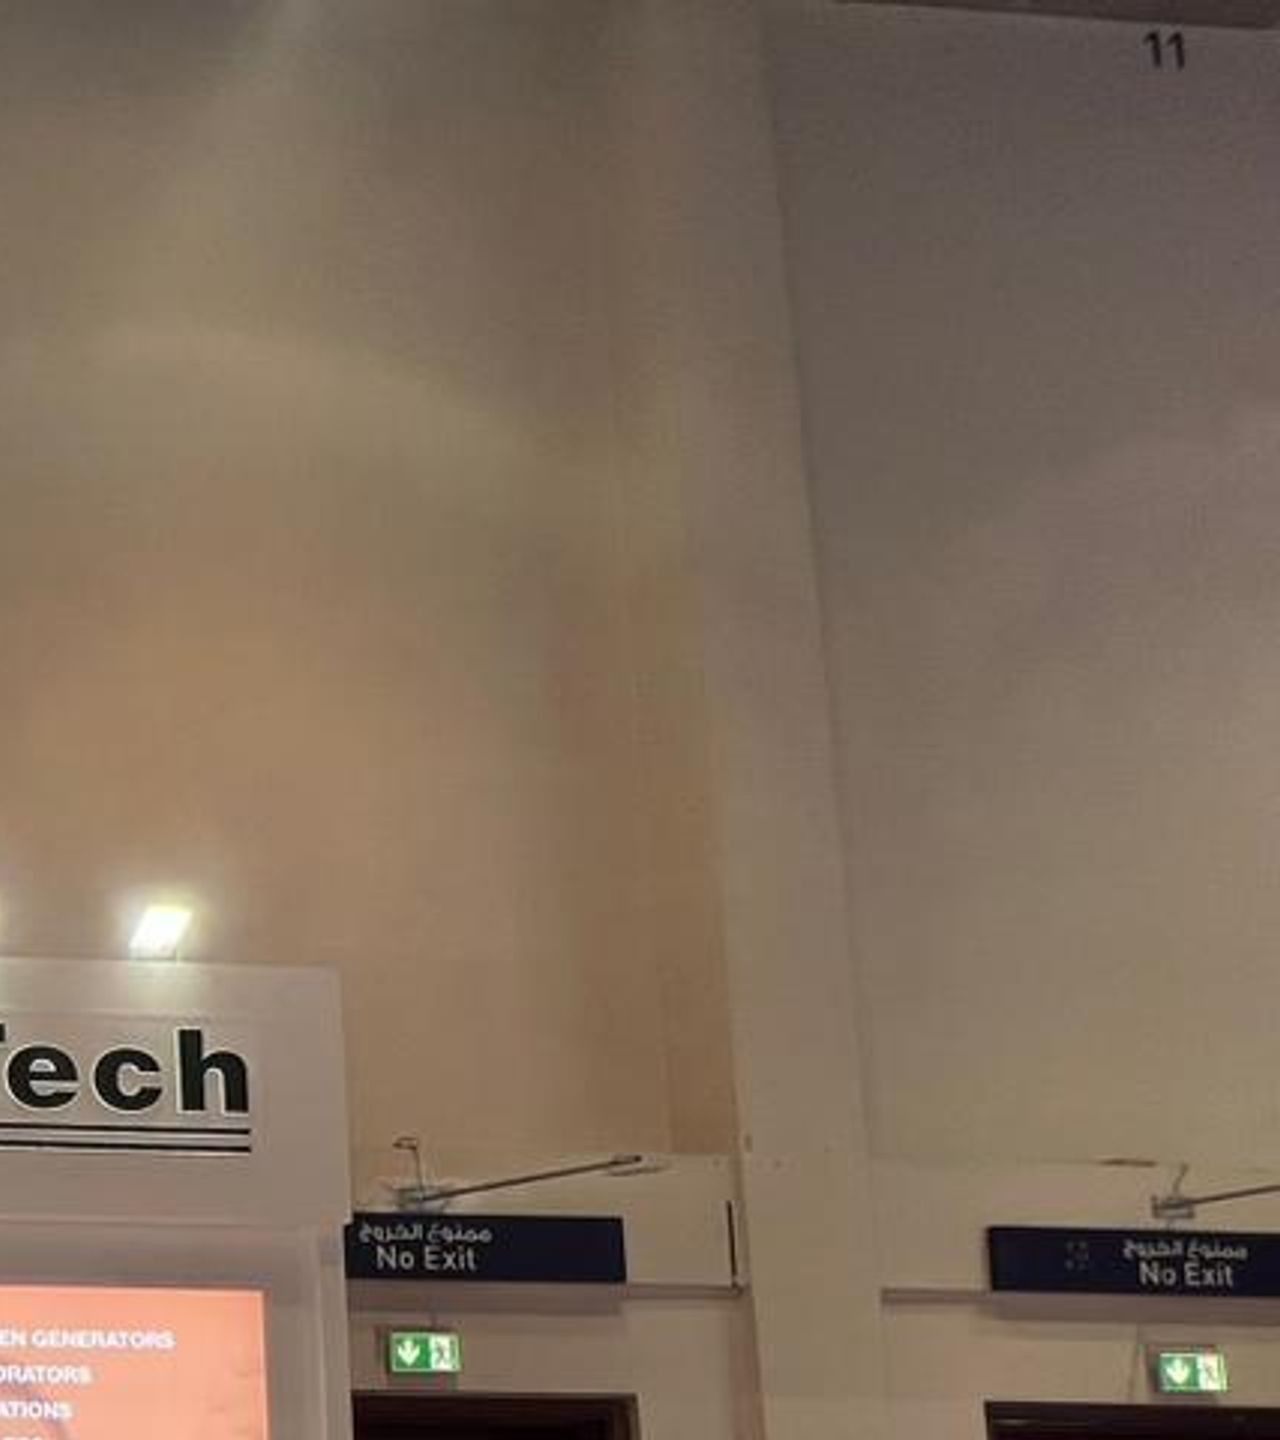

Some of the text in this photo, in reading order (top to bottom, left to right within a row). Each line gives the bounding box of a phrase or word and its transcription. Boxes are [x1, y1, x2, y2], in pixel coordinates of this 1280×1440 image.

[1143, 31, 1185, 70] 11
[375, 1245, 478, 1272] No Exit
[1140, 1261, 1235, 1288] No Exit
[32, 1330, 177, 1350] GENERATORS
